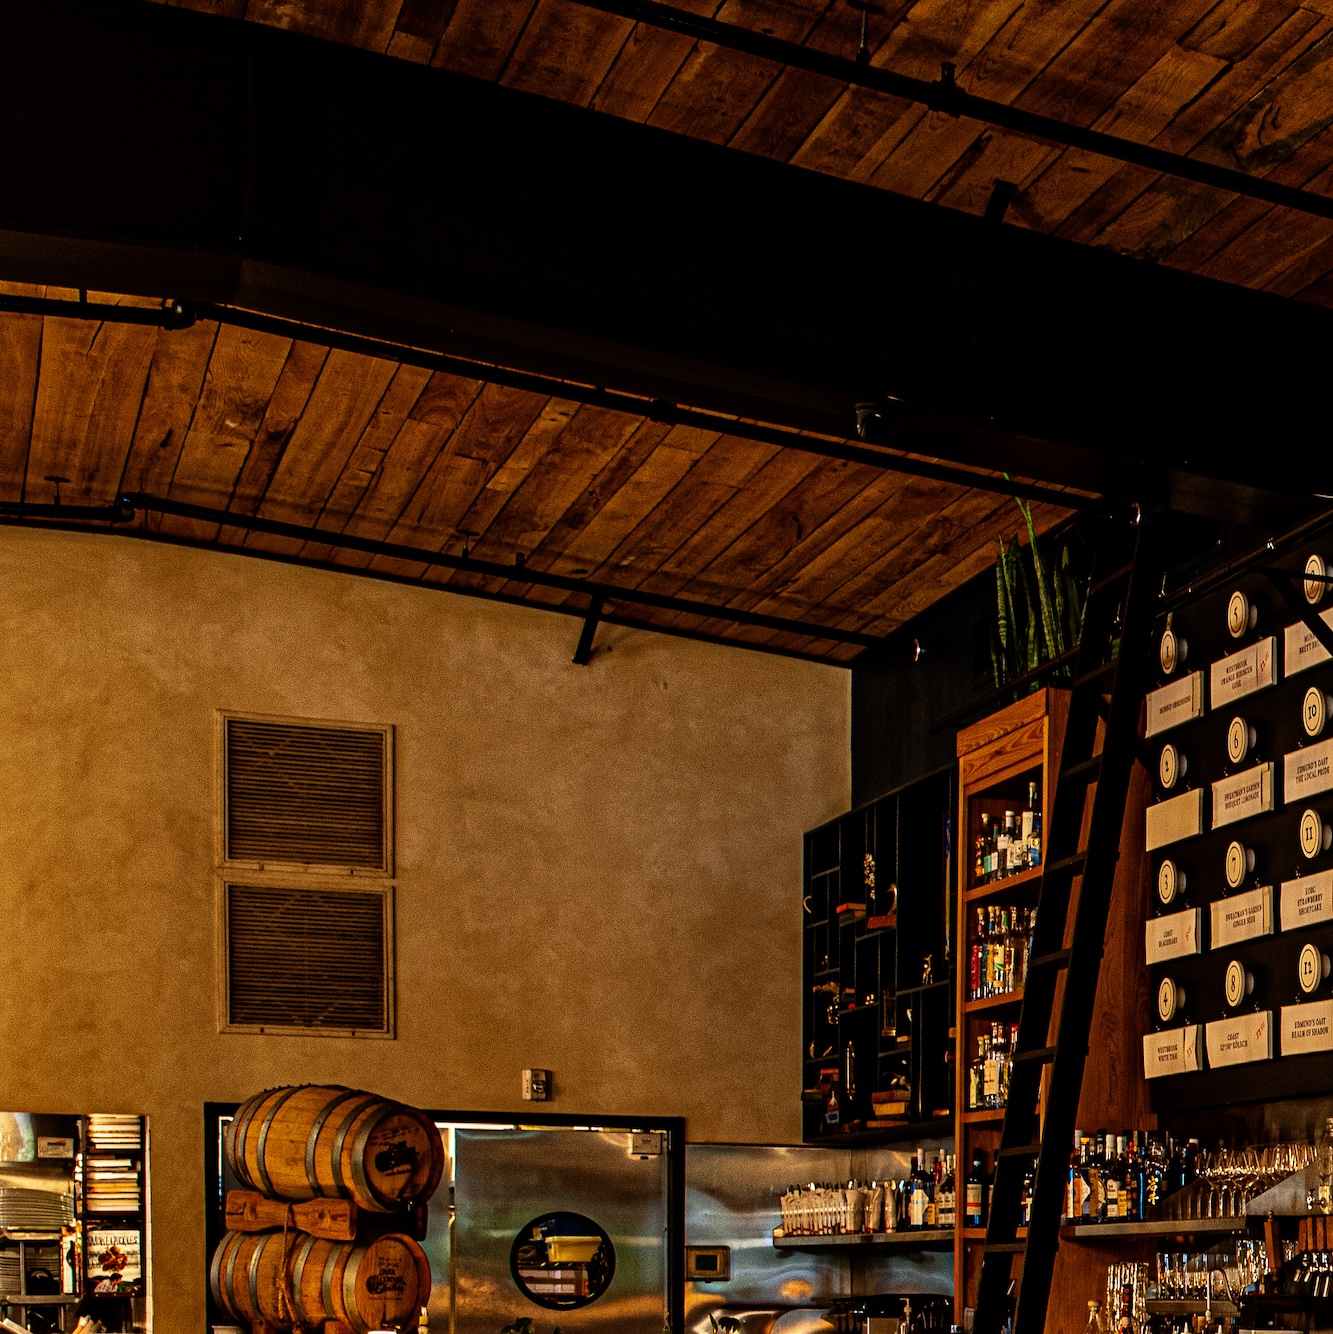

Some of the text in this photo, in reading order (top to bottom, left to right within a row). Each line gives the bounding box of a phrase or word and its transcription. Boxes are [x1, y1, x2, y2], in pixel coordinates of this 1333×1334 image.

[1308, 704, 1317, 720] 10
[1303, 961, 1312, 975] 12
[1231, 975, 1235, 992] 8
